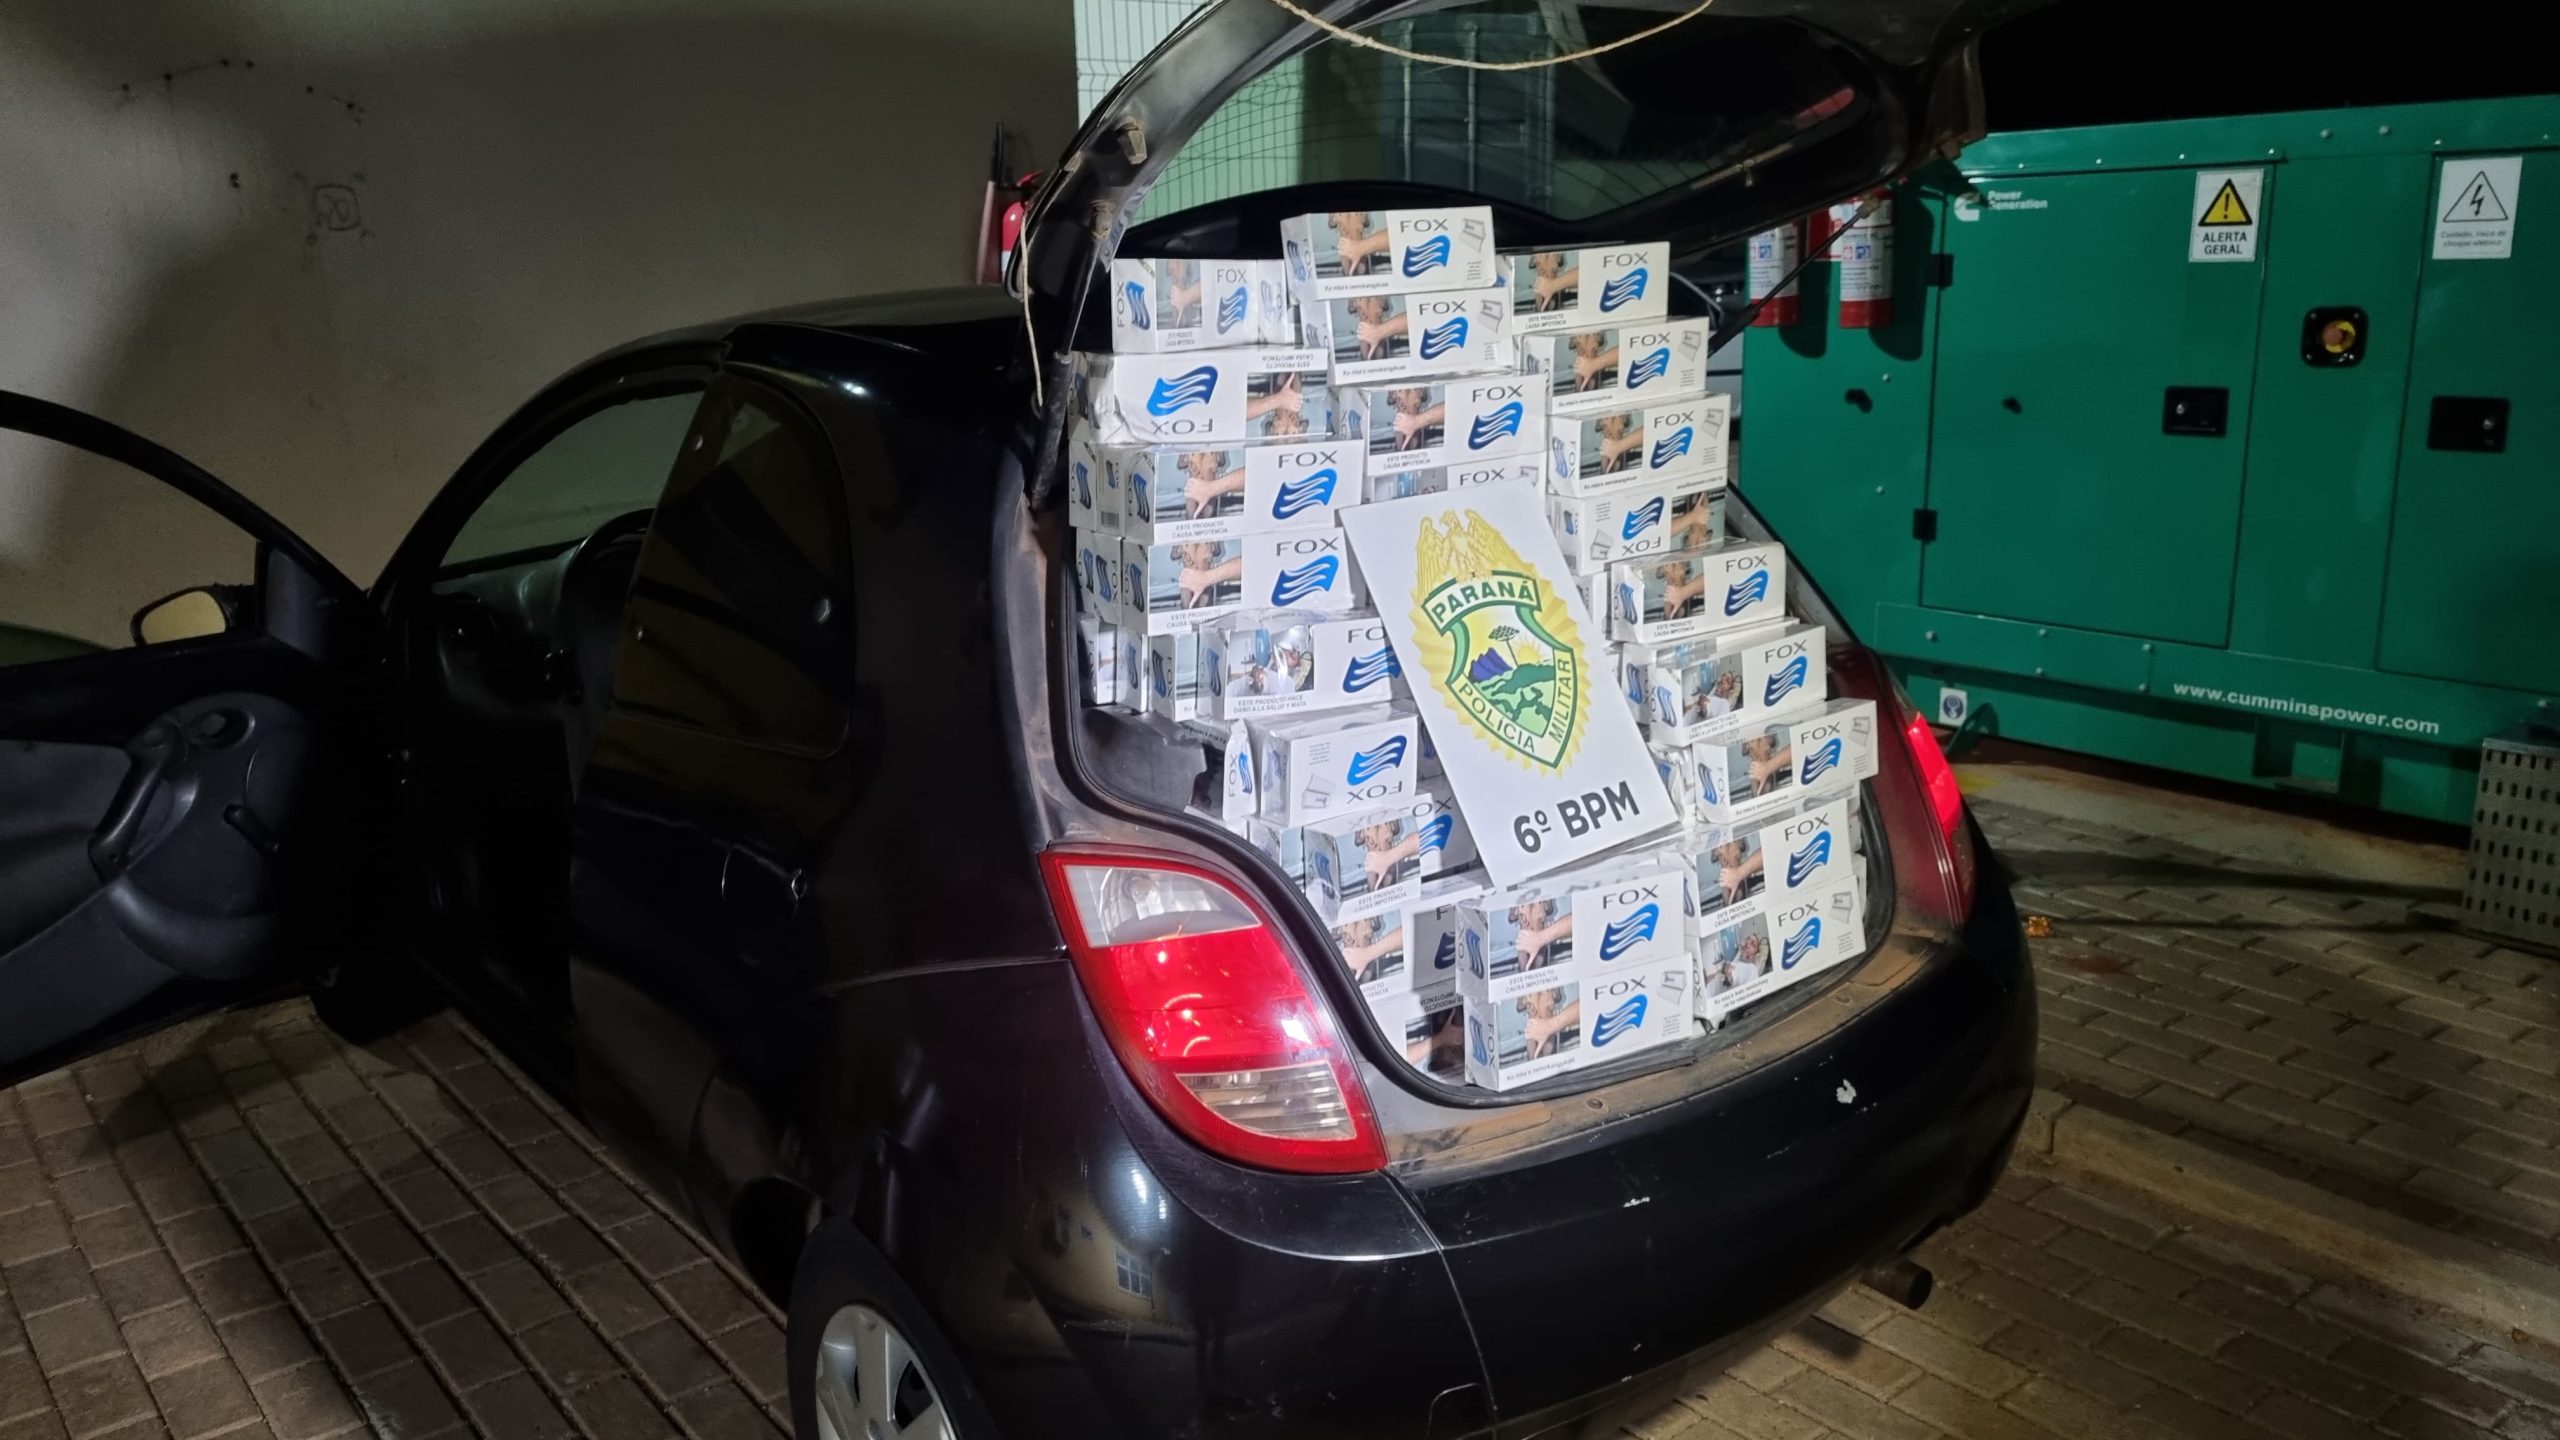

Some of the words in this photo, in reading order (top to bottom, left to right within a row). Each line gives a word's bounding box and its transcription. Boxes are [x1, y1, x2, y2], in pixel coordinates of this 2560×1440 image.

[1988, 190, 2022, 200] Power
[1988, 200, 2048, 210] Generation
[1400, 219, 1448, 233] FOX
[2202, 232, 2247, 242] ALERTA
[2204, 244, 2242, 255] GERAL
[1603, 252, 1648, 268] FOX
[1217, 269, 1247, 283] FOX
[1117, 281, 1125, 328] FOX
[1419, 300, 1467, 316] FOX
[1629, 332, 1671, 349] FOX
[1472, 384, 1524, 402] FOX
[1151, 419, 1213, 435] FOX
[1654, 410, 1694, 428] FOX
[1278, 450, 1338, 469] FOX
[1387, 455, 1399, 463] ESTE
[1400, 452, 1428, 461] PRODUCTO
[1401, 458, 1430, 468] IMPOTENCIA
[1568, 438, 1576, 480] FOX
[1460, 468, 1505, 486] FOX
[1172, 530, 1192, 539] CAUSA
[1194, 527, 1228, 537] IMPOTENCIA
[1175, 523, 1190, 531] ESTE
[1192, 520, 1225, 530] PRODUCTO
[1276, 537, 1339, 557] FOX
[1622, 537, 1661, 556] FOX
[1726, 554, 1768, 573] FOX
[1432, 580, 1534, 623] PARANÁ
[1348, 626, 1388, 644] FO
[1765, 640, 1807, 663] FOX
[1238, 698, 1255, 706] ESTE
[1255, 696, 1287, 705] PRODUCTO
[1287, 694, 1303, 702] HACE
[1548, 659, 1572, 744] MILITAR
[2173, 683, 2439, 735] www.cumminspower.com
[1800, 722, 1841, 745] FOX
[1229, 754, 1237, 798] FOX
[1347, 781, 1402, 804] FOX
[1718, 766, 1726, 805] FOX
[1514, 810, 1552, 854] 6º
[1557, 781, 1640, 839] BPM
[1784, 813, 1829, 841] FOX
[1354, 903, 1372, 912] CAUSA
[1372, 892, 1407, 907] IMPOTENCIA
[1359, 896, 1371, 905] ESTE
[1373, 886, 1403, 900] PRODUCTO
[1602, 885, 1659, 909] FOX
[1777, 900, 1819, 927] FOX
[1505, 984, 1524, 994] CAUSA
[1525, 976, 1558, 989] IMPOTENCIA
[1509, 978, 1522, 986] ESTE
[1523, 969, 1555, 982] PRODUCTO
[1594, 976, 1646, 1000] FOX
[1424, 998, 1456, 1012] PRODUCTO
[1487, 1023, 1496, 1068] FOX
